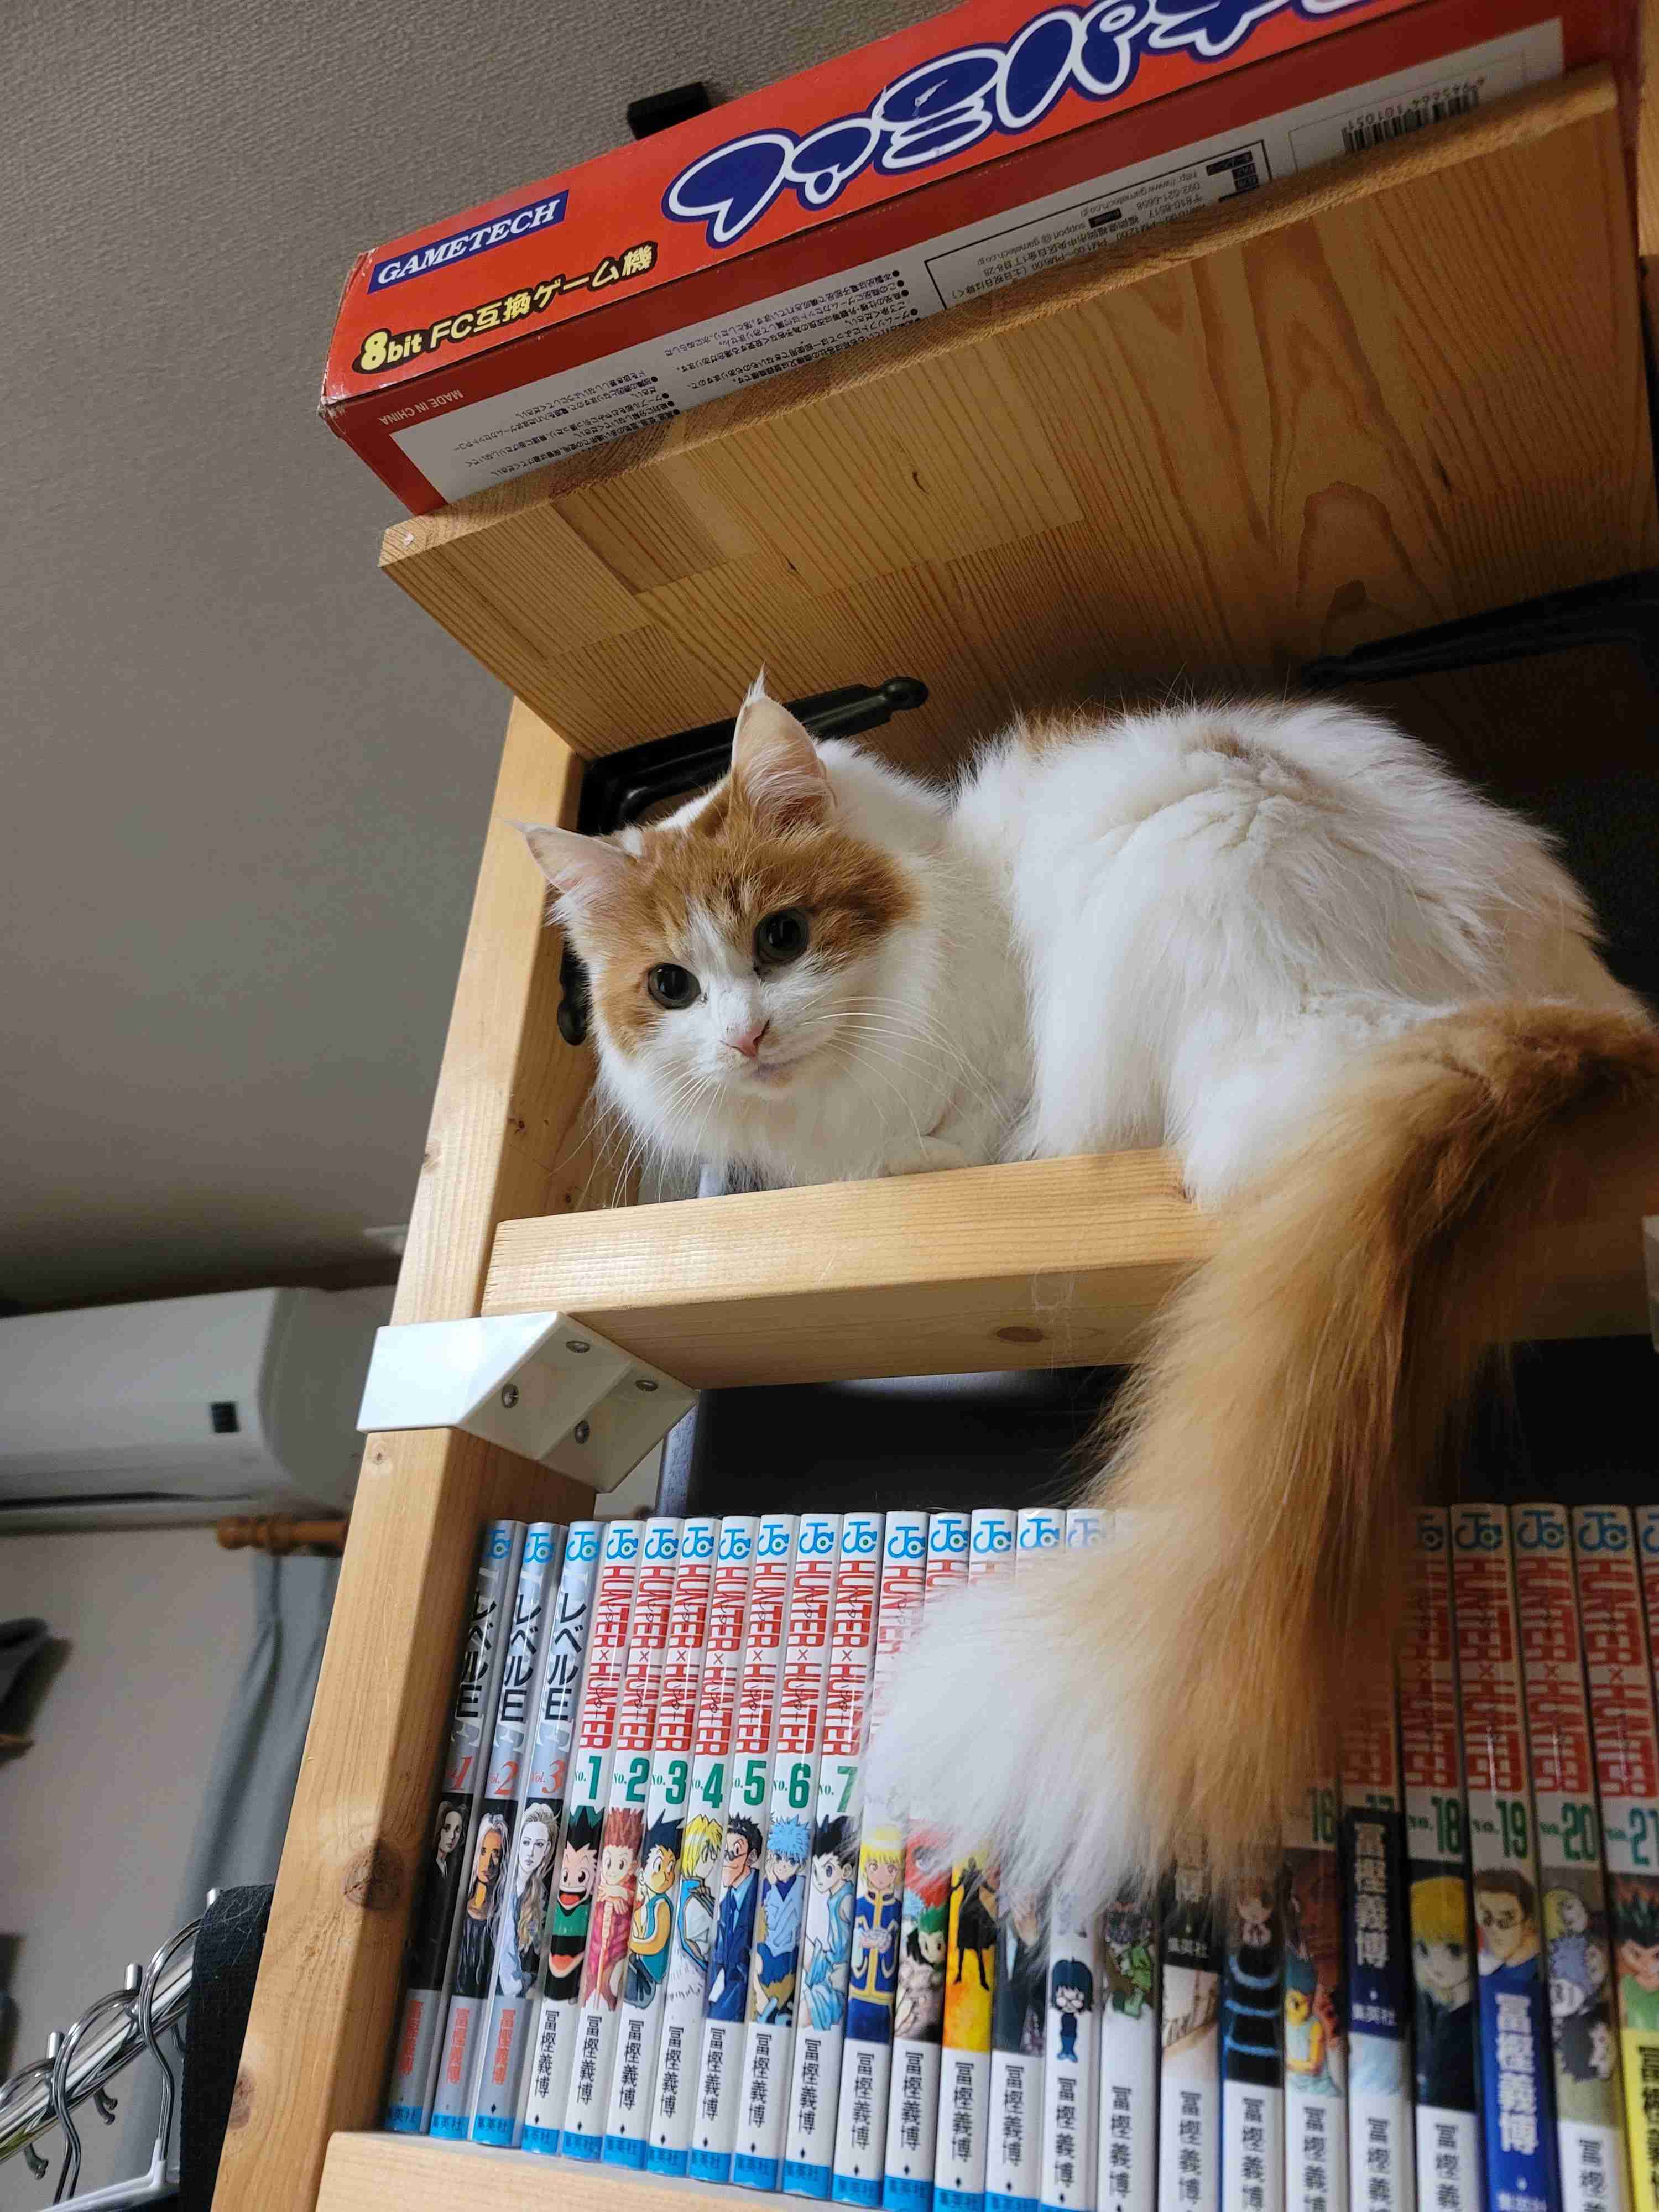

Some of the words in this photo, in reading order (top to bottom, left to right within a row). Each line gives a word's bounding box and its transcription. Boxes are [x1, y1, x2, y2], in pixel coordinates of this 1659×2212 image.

[377, 199, 560, 285] GAMETECH
[361, 331, 422, 371] 8bit
[429, 244, 654, 349] FC互換ゲーム機
[378, 408, 415, 426] CHINA
[414, 401, 430, 415] IN
[430, 389, 464, 409] MADE
[499, 1594, 542, 1722] レベルE
[544, 1592, 587, 1721] レベルE
